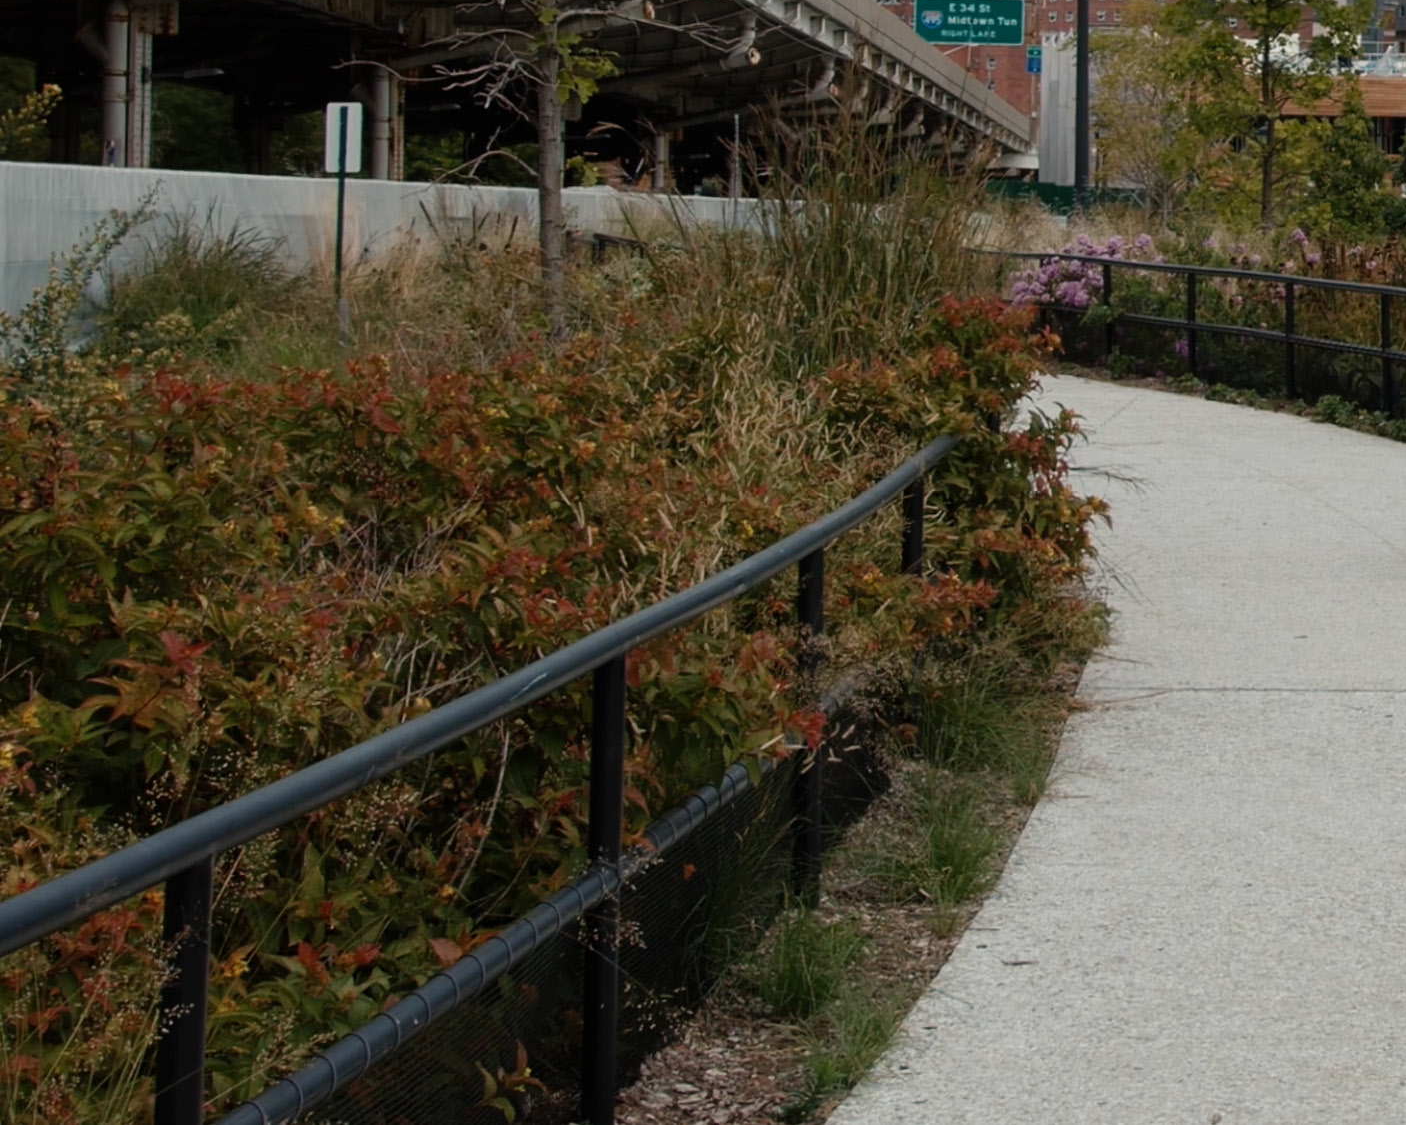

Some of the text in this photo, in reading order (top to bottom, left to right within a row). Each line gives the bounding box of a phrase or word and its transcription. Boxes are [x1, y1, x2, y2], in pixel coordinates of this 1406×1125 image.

[949, 3, 991, 13] E 34 St
[923, 16, 943, 25] 495
[947, 16, 1017, 26] Midtown Tun
[941, 29, 968, 37] RIGHT
